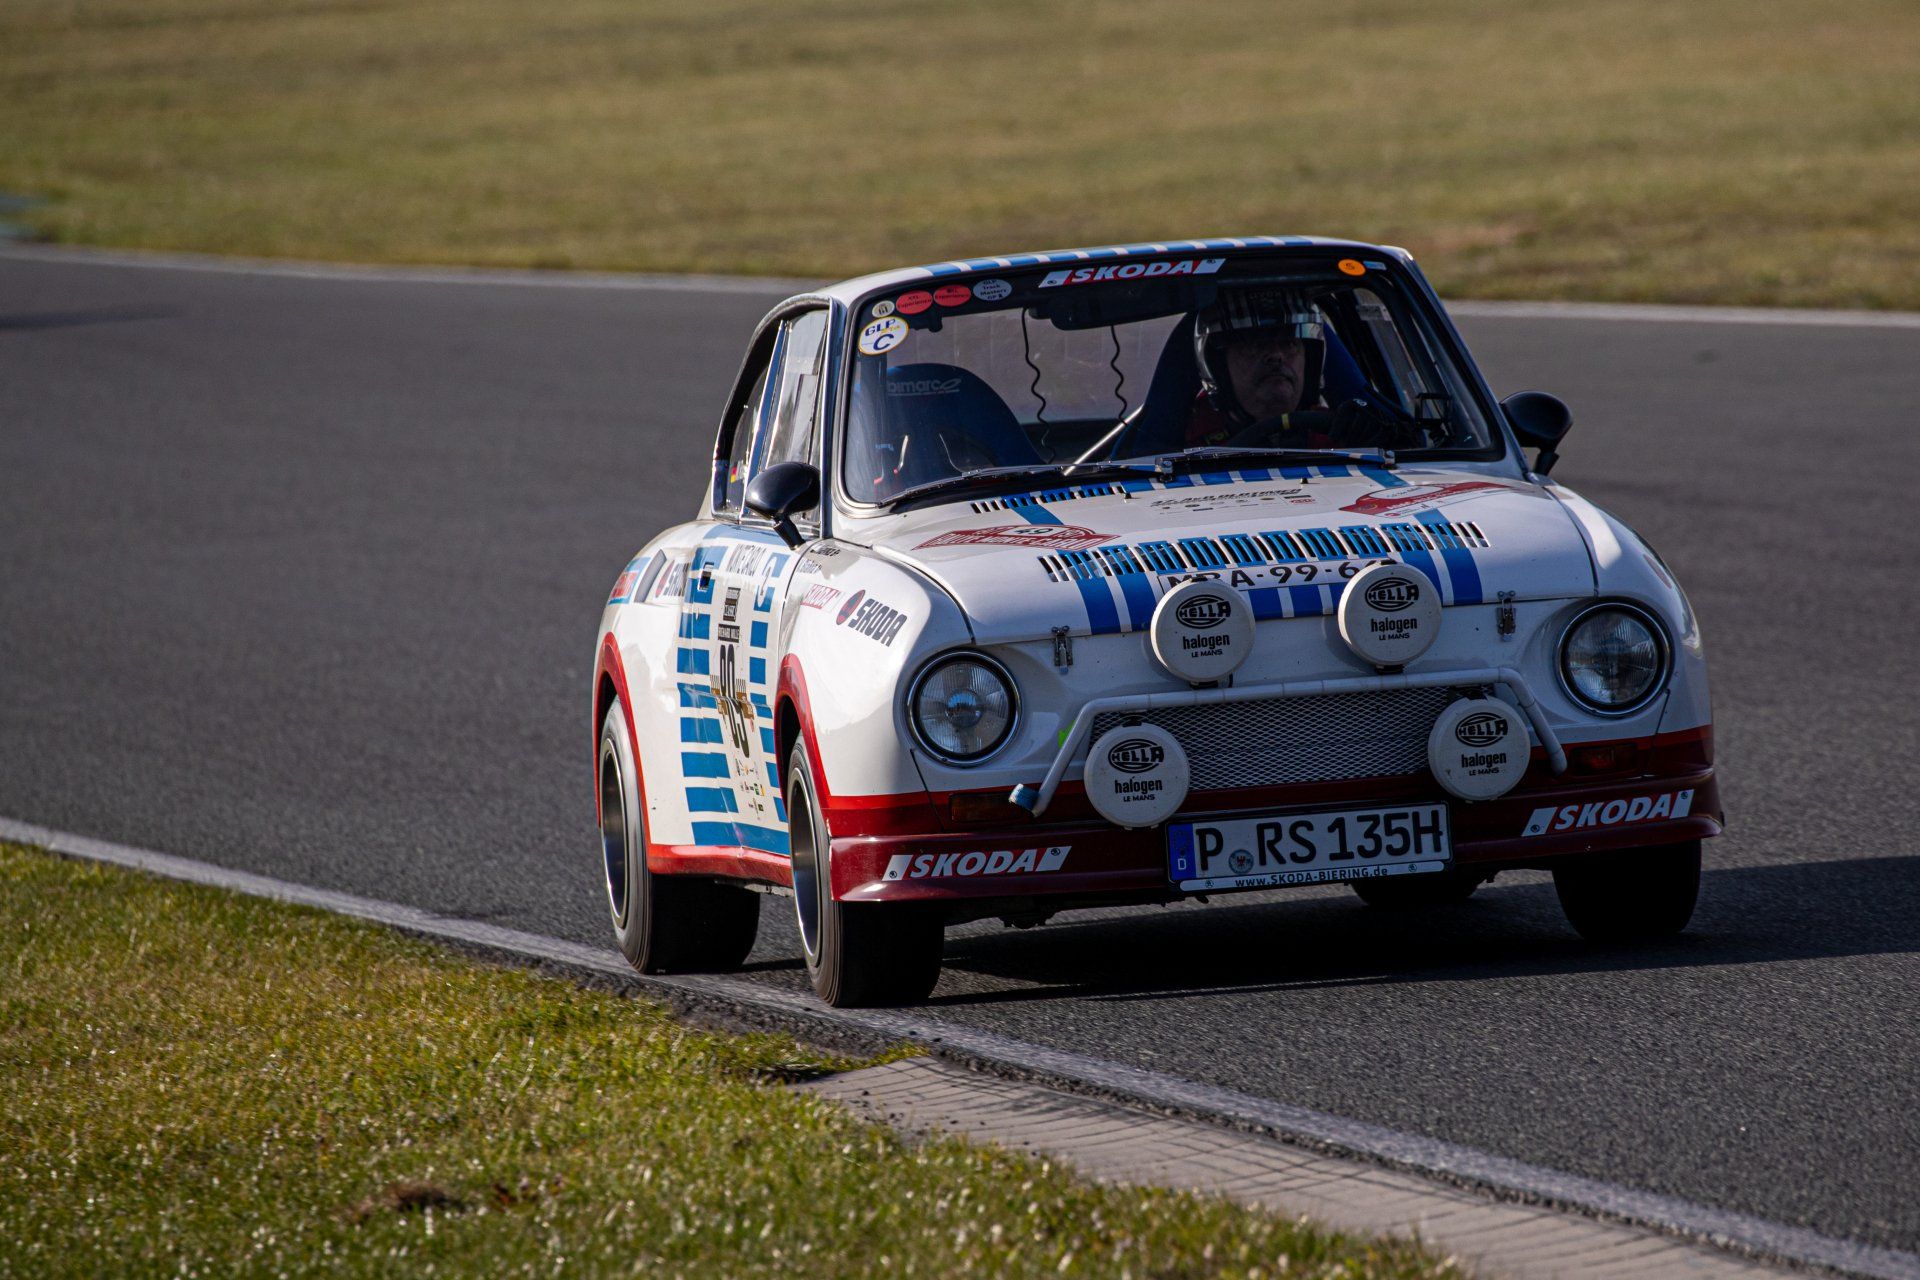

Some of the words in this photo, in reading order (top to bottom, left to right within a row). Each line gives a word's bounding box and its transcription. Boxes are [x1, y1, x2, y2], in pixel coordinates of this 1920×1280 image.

[1071, 260, 1195, 281] SKODA
[865, 319, 896, 336] GLP
[873, 333, 895, 350] C
[1368, 584, 1420, 601] HELLA
[1180, 601, 1232, 618] HELLA
[1370, 617, 1418, 633] halogen
[1182, 634, 1231, 650] halogen
[1200, 649, 1223, 657] MANS
[1459, 718, 1509, 736] HELLA
[1111, 746, 1165, 762] HELLA
[1461, 752, 1507, 768] halogen
[1114, 778, 1163, 794] halogen
[1554, 794, 1672, 830] SKODA
[1195, 827, 1224, 870] P
[1256, 820, 1317, 866] RS
[1322, 809, 1444, 861] 135H
[910, 849, 1038, 878] SKODA
[1178, 857, 1187, 870] D
[1234, 867, 1388, 887] www.SKODA-BIERING.de
